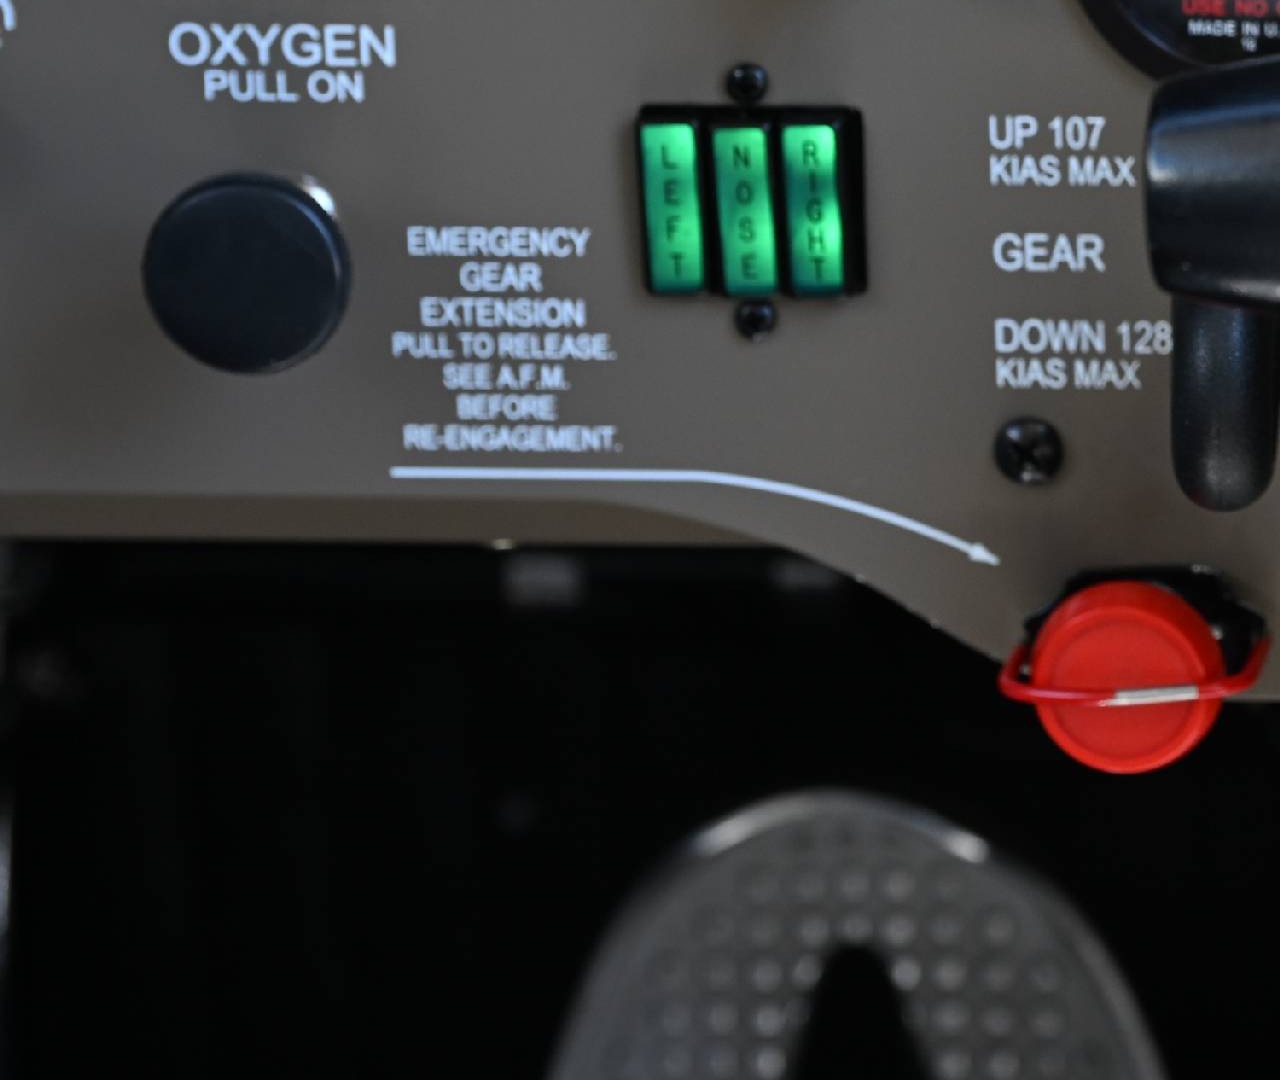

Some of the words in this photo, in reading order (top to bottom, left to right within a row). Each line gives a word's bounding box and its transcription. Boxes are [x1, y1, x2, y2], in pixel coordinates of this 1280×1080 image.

[168, 22, 396, 67] OXYGEN
[1187, 20, 1236, 36] MADE
[1241, 21, 1260, 37] IN
[204, 70, 298, 102] PULL
[307, 70, 365, 102] ON
[989, 116, 1038, 150] UP
[1048, 116, 1105, 150] 107
[990, 155, 1061, 186] KIAS
[1068, 156, 1136, 187] MAX
[661, 146, 684, 279] LEFT
[733, 146, 756, 279] NOSE
[803, 140, 826, 279] RIGHT
[407, 226, 591, 257] EMERGENCY
[993, 232, 1105, 271] GEAR
[459, 261, 543, 292] GEAR
[419, 296, 587, 328] EXTENSION
[391, 331, 454, 358] PULL
[458, 331, 495, 360] TO
[994, 319, 1105, 353] DOWN
[1117, 321, 1173, 354] 128
[443, 362, 492, 390] SEE
[995, 358, 1066, 389] KIAS
[1074, 359, 1142, 390] MAX
[456, 394, 558, 420] BEFORE
